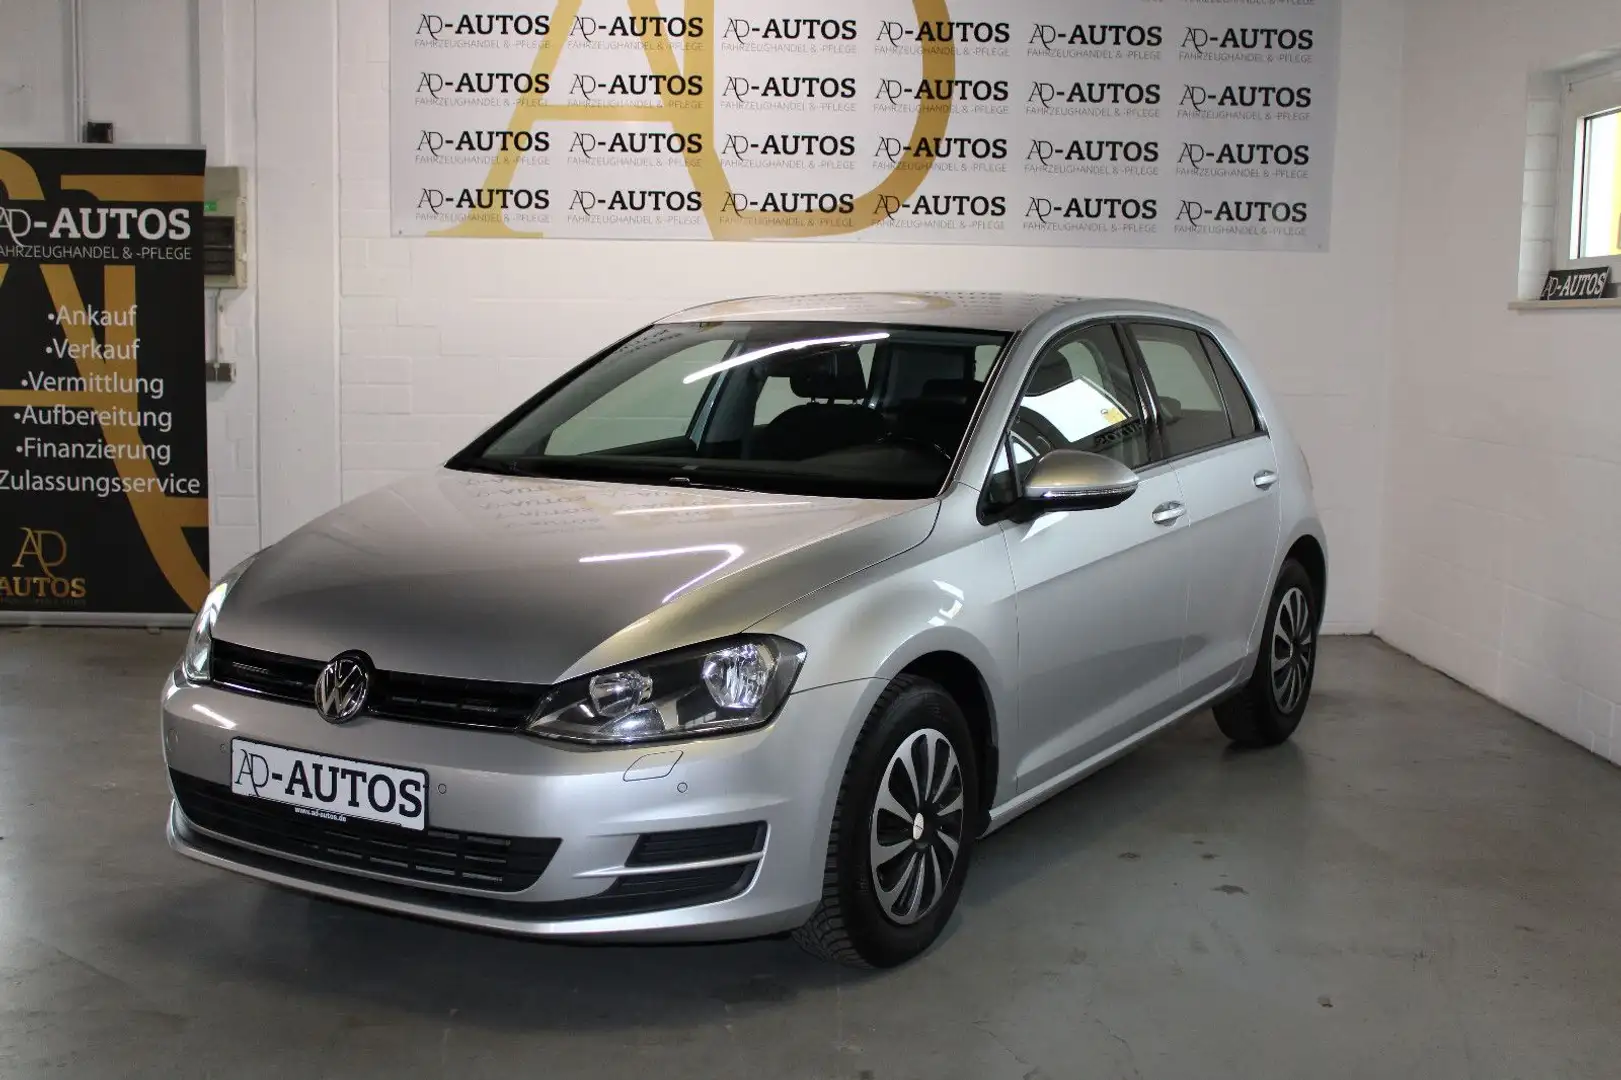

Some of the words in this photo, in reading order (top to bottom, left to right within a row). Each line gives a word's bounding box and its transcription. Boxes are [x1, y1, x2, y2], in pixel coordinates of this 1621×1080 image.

[416, 14, 550, 40] AD-AUTOS
[570, 16, 703, 43] AD-AUTOS
[723, 18, 857, 45] AD-AUTOS
[876, 21, 1010, 48] AD-AUTOS
[1029, 24, 1162, 51] AD-AUTOS
[1182, 27, 1313, 54] AD-AUTOS
[417, 72, 550, 99] AD-AUTOS
[570, 74, 703, 101] AD-AUTOS
[723, 76, 856, 103] AD-AUTOS
[876, 79, 1008, 105] AD-AUTOS
[1028, 82, 1160, 108] AD-AUTOS
[1179, 85, 1311, 112] AD-AUTOS
[417, 131, 549, 157] AD-AUTOS
[570, 132, 702, 159] AD-AUTOS
[722, 134, 855, 161] AD-AUTOS
[875, 137, 1007, 163] AD-AUTOS
[1027, 140, 1158, 166] AD-AUTOS
[1178, 143, 1309, 169] AD-AUTOS
[417, 189, 549, 215] AD-AUTOS
[569, 190, 702, 216] AD-AUTOS
[721, 192, 854, 217] AD-AUTOS
[873, 194, 1006, 221] AD-AUTOS
[1025, 197, 1157, 224] AD-AUTOS
[1176, 200, 1307, 227] AD-AUTOS
[122, 247, 133, 259] &
[136, 247, 192, 260] -PFLEGE
[0, 469, 201, 497] Zulassungsservice
[234, 749, 422, 818] AD-AUTOS
